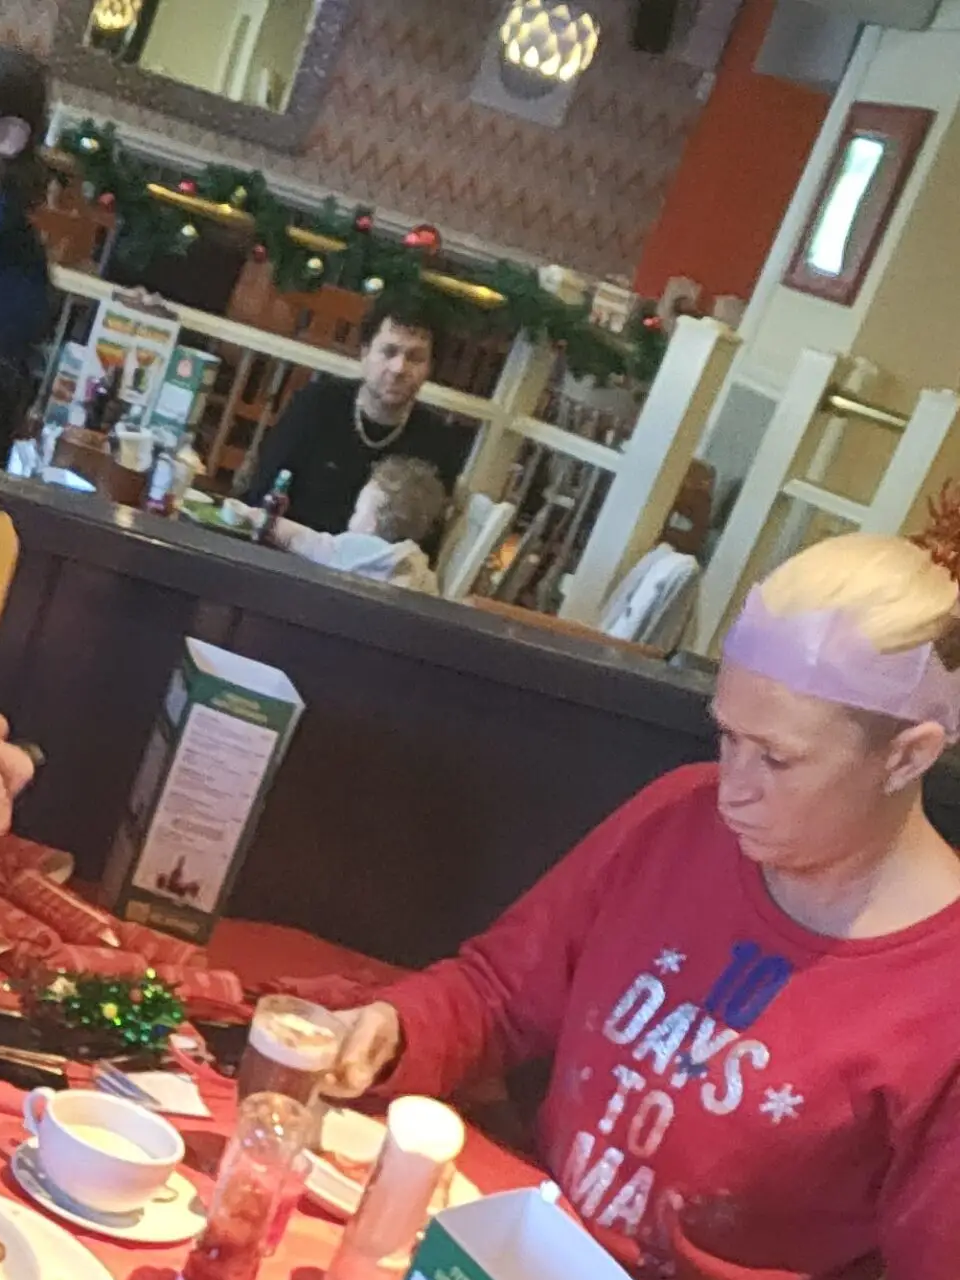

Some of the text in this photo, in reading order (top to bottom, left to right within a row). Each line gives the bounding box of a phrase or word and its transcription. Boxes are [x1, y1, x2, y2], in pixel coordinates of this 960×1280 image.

[704, 940, 795, 1031] 10
[602, 972, 771, 1116] DAYS
[597, 1063, 676, 1159] TO
